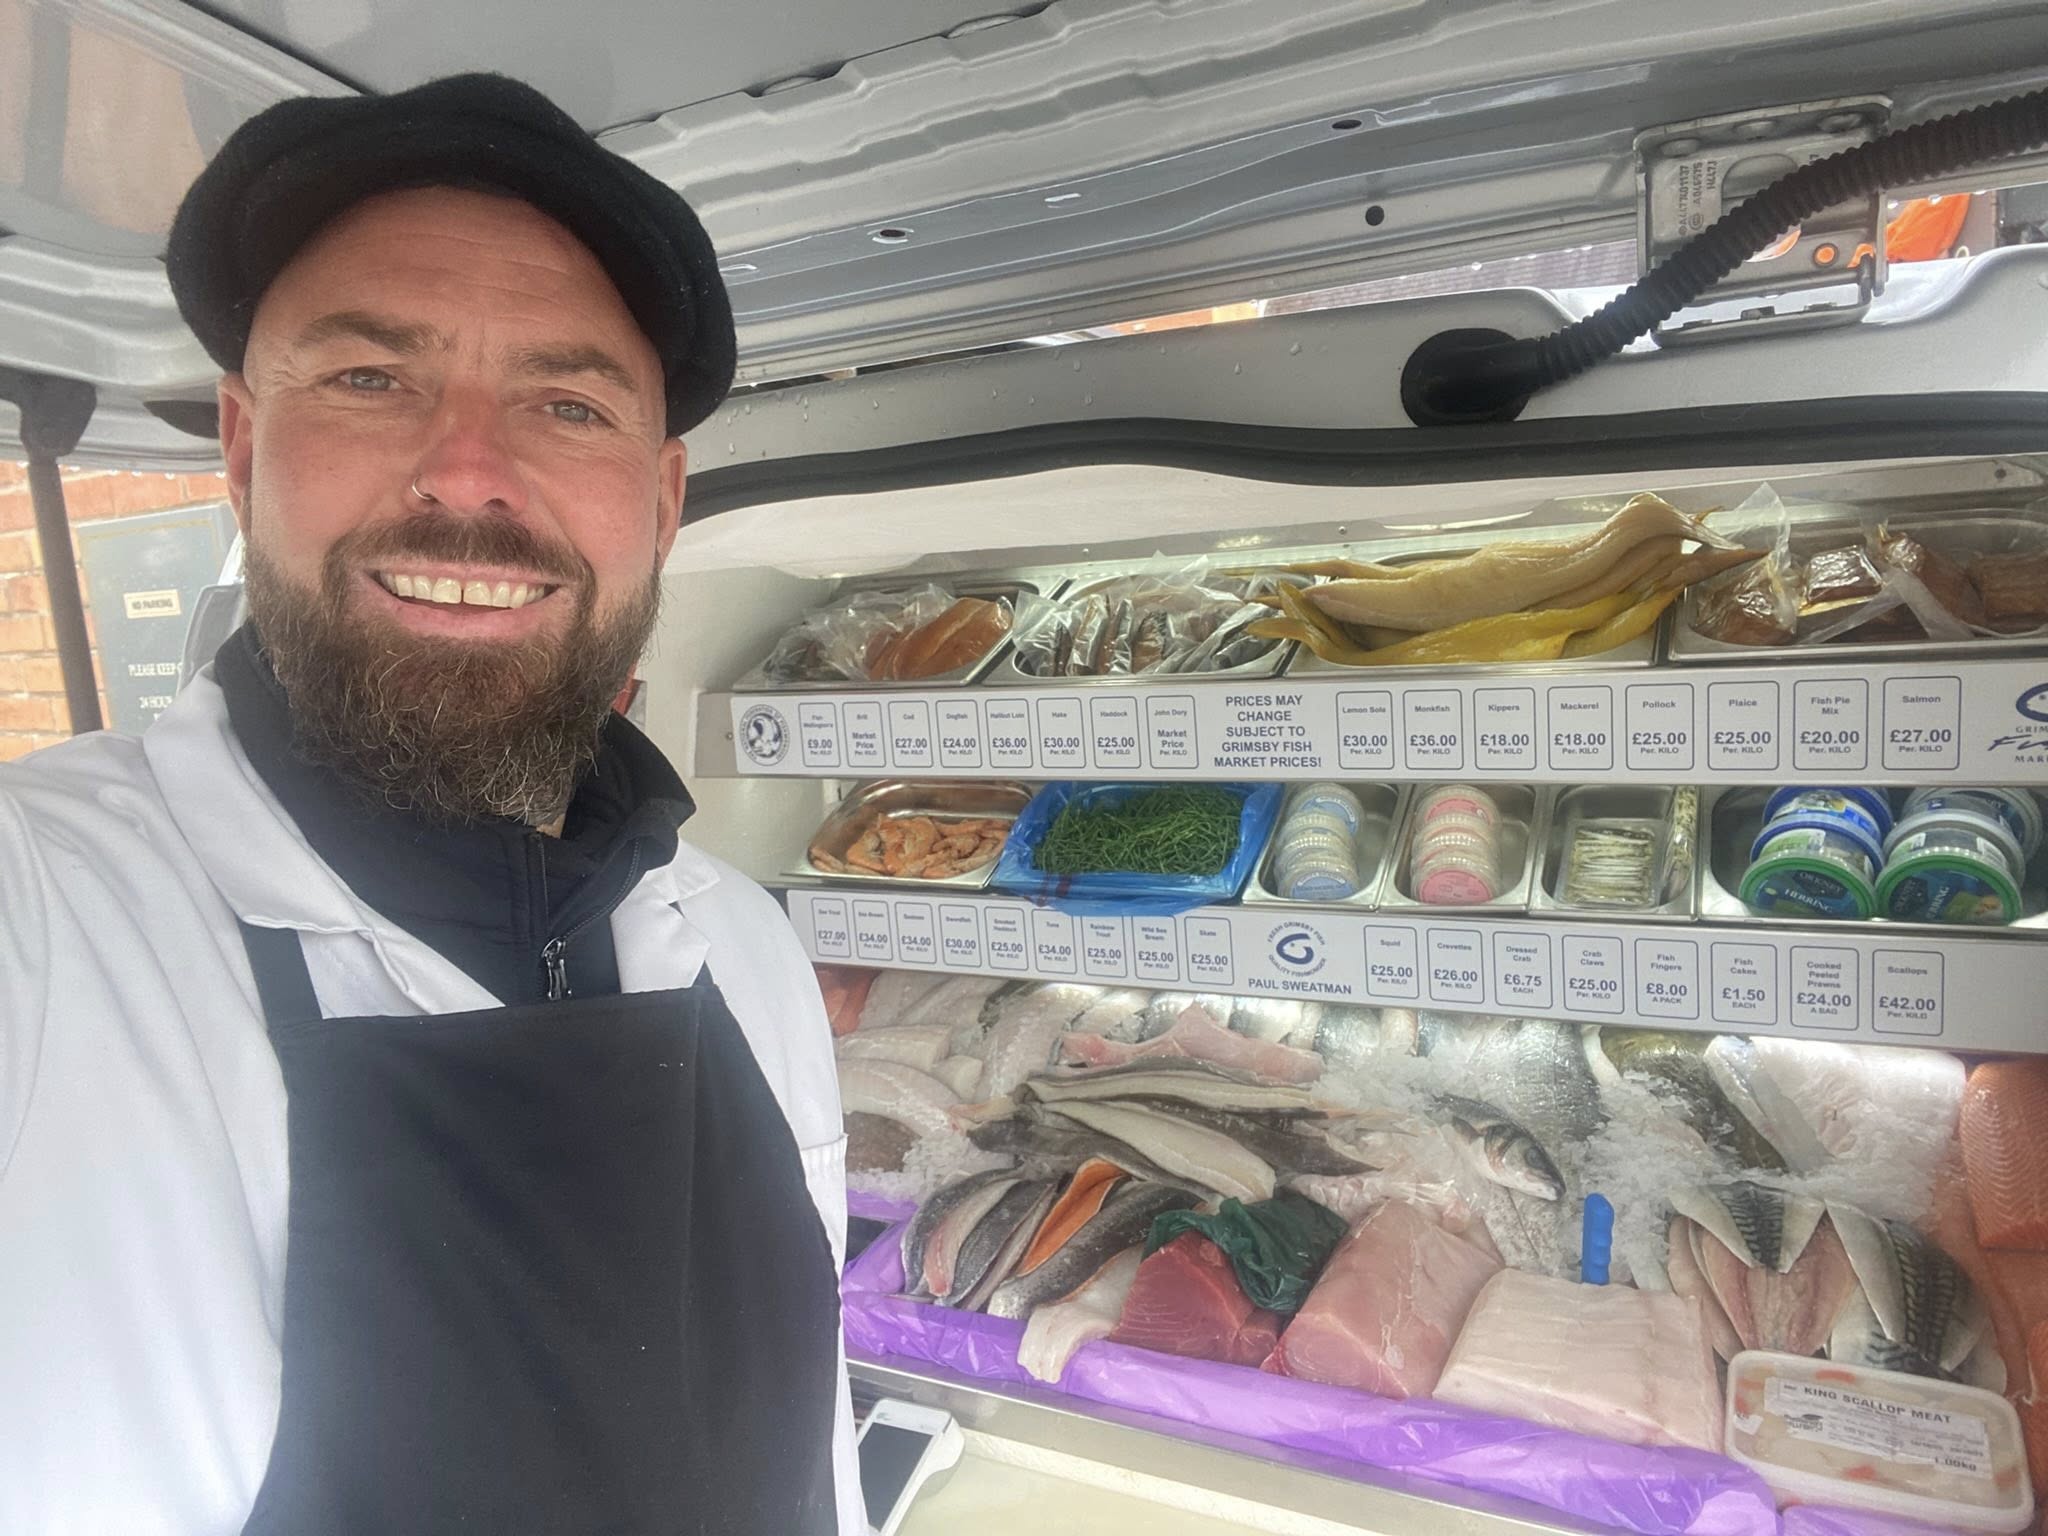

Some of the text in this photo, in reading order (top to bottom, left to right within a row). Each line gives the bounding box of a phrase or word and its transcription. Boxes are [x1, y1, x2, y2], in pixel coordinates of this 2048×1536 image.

[1225, 695, 1303, 707] PRICES MAY
[1728, 699, 1757, 707] Plaice
[1811, 696, 1850, 705] Fish Pie
[1902, 695, 1941, 704] Salmon
[1342, 706, 1368, 714] Lemon
[1414, 705, 1450, 713] Monkfish
[1488, 704, 1520, 713] Kippers
[1560, 702, 1599, 710] Mackerel
[1642, 701, 1676, 709] Pollock
[1154, 709, 1187, 717] John Dory
[1237, 710, 1292, 722] CHANGE
[1821, 707, 1839, 715] Mix
[852, 732, 877, 740] Market
[1157, 729, 1187, 738] Market
[1226, 726, 1306, 737] SUBJECT TO
[1890, 729, 1951, 743] £27.00
[1044, 737, 1080, 748] £30.00
[1097, 736, 1135, 748] £25.00
[1343, 735, 1388, 747] £30.00
[1410, 735, 1457, 746] £36.00
[1480, 734, 1529, 746] £18.00
[1554, 733, 1606, 745] £18.00
[1632, 732, 1687, 745] £25.00
[1714, 731, 1772, 745] £25.00
[1800, 731, 1860, 744] £20.00
[808, 739, 833, 749] £9.00
[855, 741, 874, 750] Price
[895, 738, 928, 749] £27.00
[943, 738, 976, 748] £24.00
[992, 738, 1027, 748] £36.00
[1161, 740, 1184, 748] Price
[1221, 741, 1312, 752] GRIMSBY FISH
[1579, 747, 1599, 755] KILO
[1658, 746, 1679, 754] KILO
[1741, 746, 1764, 754] KILO
[1828, 746, 1851, 754] KILO
[1919, 745, 1943, 753] KILO
[1214, 756, 1322, 768] MARKET PRICES!
[1090, 923, 1115, 931] Rainbow
[818, 931, 846, 941] £27.00
[859, 933, 888, 943] £34.00
[1267, 921, 1325, 946] FRESH GRIMSBY FISH
[901, 935, 932, 946] £34.00
[945, 938, 977, 949] £30.00
[1380, 939, 1401, 948] Squid
[991, 942, 1023, 953] £25.00
[1039, 944, 1072, 956] £34.00
[1437, 942, 1472, 951] Crevettes
[1505, 945, 1538, 954] Dressed
[1087, 947, 1122, 959] £25.00
[1138, 951, 1174, 963] £25.00
[1512, 954, 1532, 962] Crab
[1582, 950, 1602, 958] Crab
[1657, 954, 1676, 962] Fish
[1191, 954, 1228, 966] £25.00
[1268, 954, 1290, 975] QUALITY
[1580, 958, 1605, 967] Claws
[1734, 958, 1754, 966] Fish
[1650, 962, 1682, 971] Fingers
[1806, 961, 1842, 970] Cooked
[1887, 966, 1928, 975] Scallops
[1371, 964, 1413, 978] £25.00
[1434, 969, 1478, 982] £26.00
[1730, 967, 1757, 975] Cakes
[1808, 971, 1840, 979] Peeled
[1504, 973, 1542, 987] £6.75
[1569, 978, 1617, 991] £25.00
[1807, 980, 1841, 989] Prawns
[1248, 978, 1352, 994] PAUL SWEATMAN
[1512, 986, 1534, 994] EACH
[1646, 983, 1688, 996] £8.00
[1591, 992, 1611, 1000] KILO
[1722, 987, 1766, 1001] £1.50
[1797, 992, 1851, 1007] £24.00
[1879, 996, 1936, 1011] £42.00
[1732, 1001, 1756, 1009] EACH
[1818, 1007, 1838, 1015] BAG
[1905, 1012, 1928, 1020] KILO
[1804, 1386, 1837, 1399] KING
[1843, 1394, 1906, 1415] SCALLOP
[1911, 1410, 1952, 1424] MEAT
